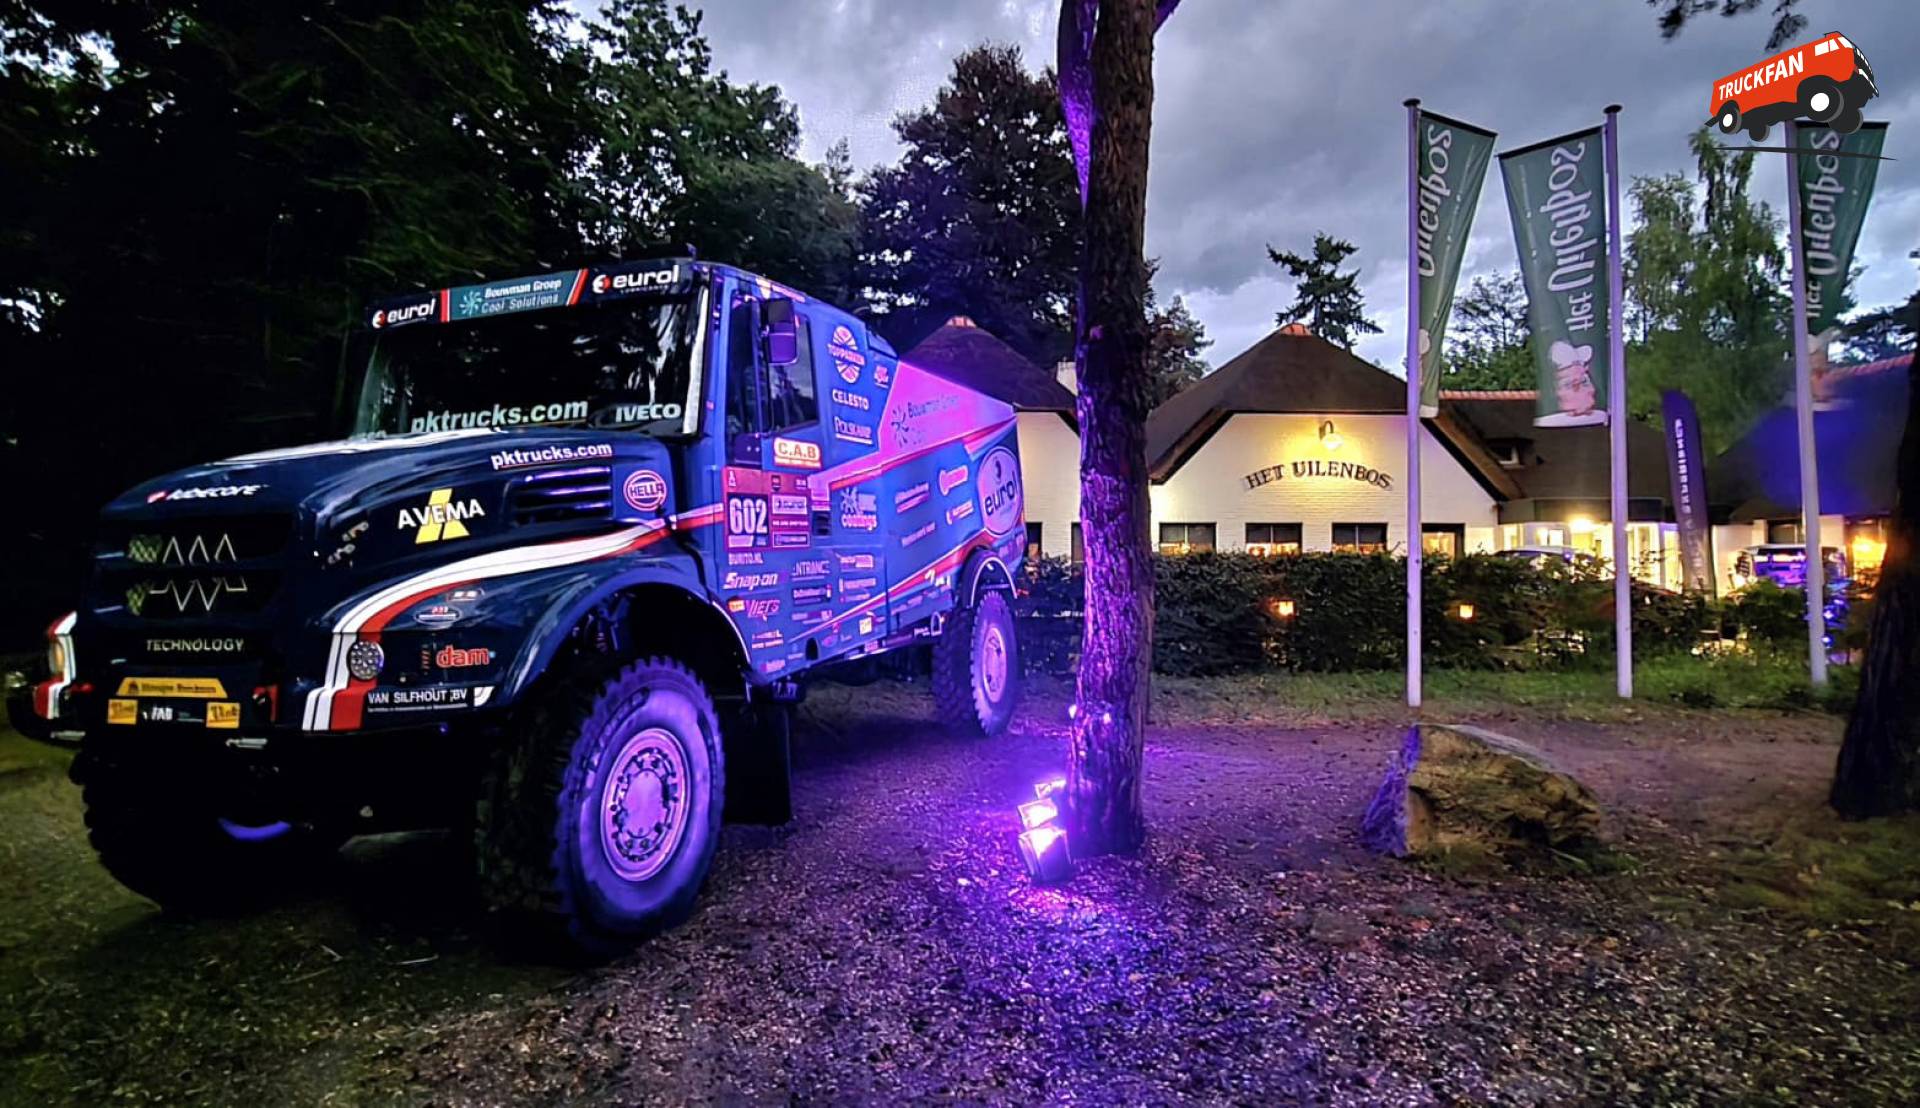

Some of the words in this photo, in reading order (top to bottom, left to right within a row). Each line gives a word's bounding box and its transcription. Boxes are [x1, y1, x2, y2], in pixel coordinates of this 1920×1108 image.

[533, 279, 562, 292] Groep
[612, 265, 679, 288] eurol
[387, 299, 436, 323] eurol
[510, 293, 559, 309] Solutions
[832, 388, 870, 411] CELESTO
[411, 400, 588, 434] pktrucks.com
[615, 403, 682, 422] IVECO
[491, 443, 612, 470] pktrucks.com
[1245, 464, 1285, 490] HET
[1291, 460, 1394, 489] UILENBOS
[629, 482, 664, 498] HELLA
[984, 472, 1018, 516] eurol
[397, 499, 485, 530] AVEMA
[729, 498, 768, 535] 602
[723, 572, 779, 590] Snap-on
[146, 639, 244, 651] TECHNOLOGY
[436, 645, 489, 668] dam
[368, 692, 389, 705] VAN
[394, 690, 448, 704] SILFHOUT
